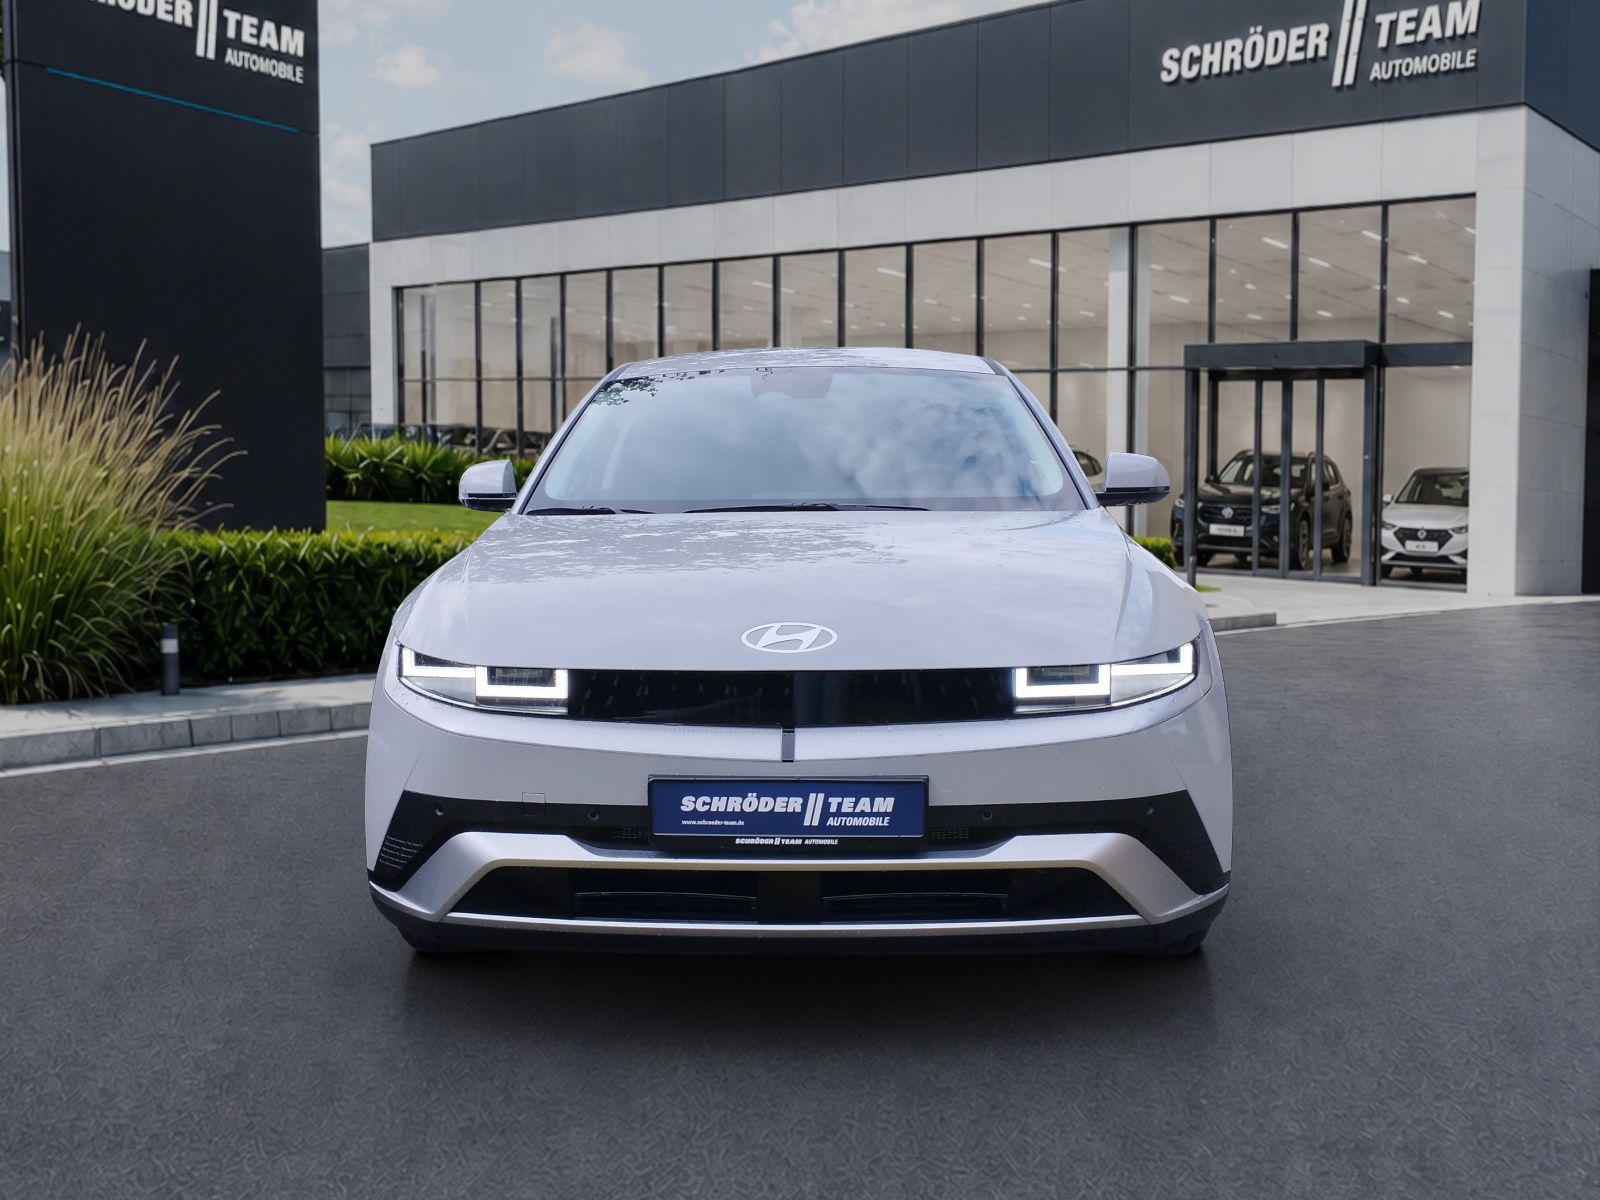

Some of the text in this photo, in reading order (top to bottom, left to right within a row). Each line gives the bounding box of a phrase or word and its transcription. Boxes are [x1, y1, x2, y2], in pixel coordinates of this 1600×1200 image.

[222, 9, 305, 57] TEAM
[1160, 0, 1482, 83] SCHRÖDER TEAM
[224, 47, 304, 84] AUTOMOBILE
[1369, 48, 1478, 82] AUTOMOBILE
[680, 792, 895, 813] SCHRÖDER TEAM
[826, 816, 891, 827] AUTOMOBILE
[735, 837, 774, 845] SCHRÖDER
